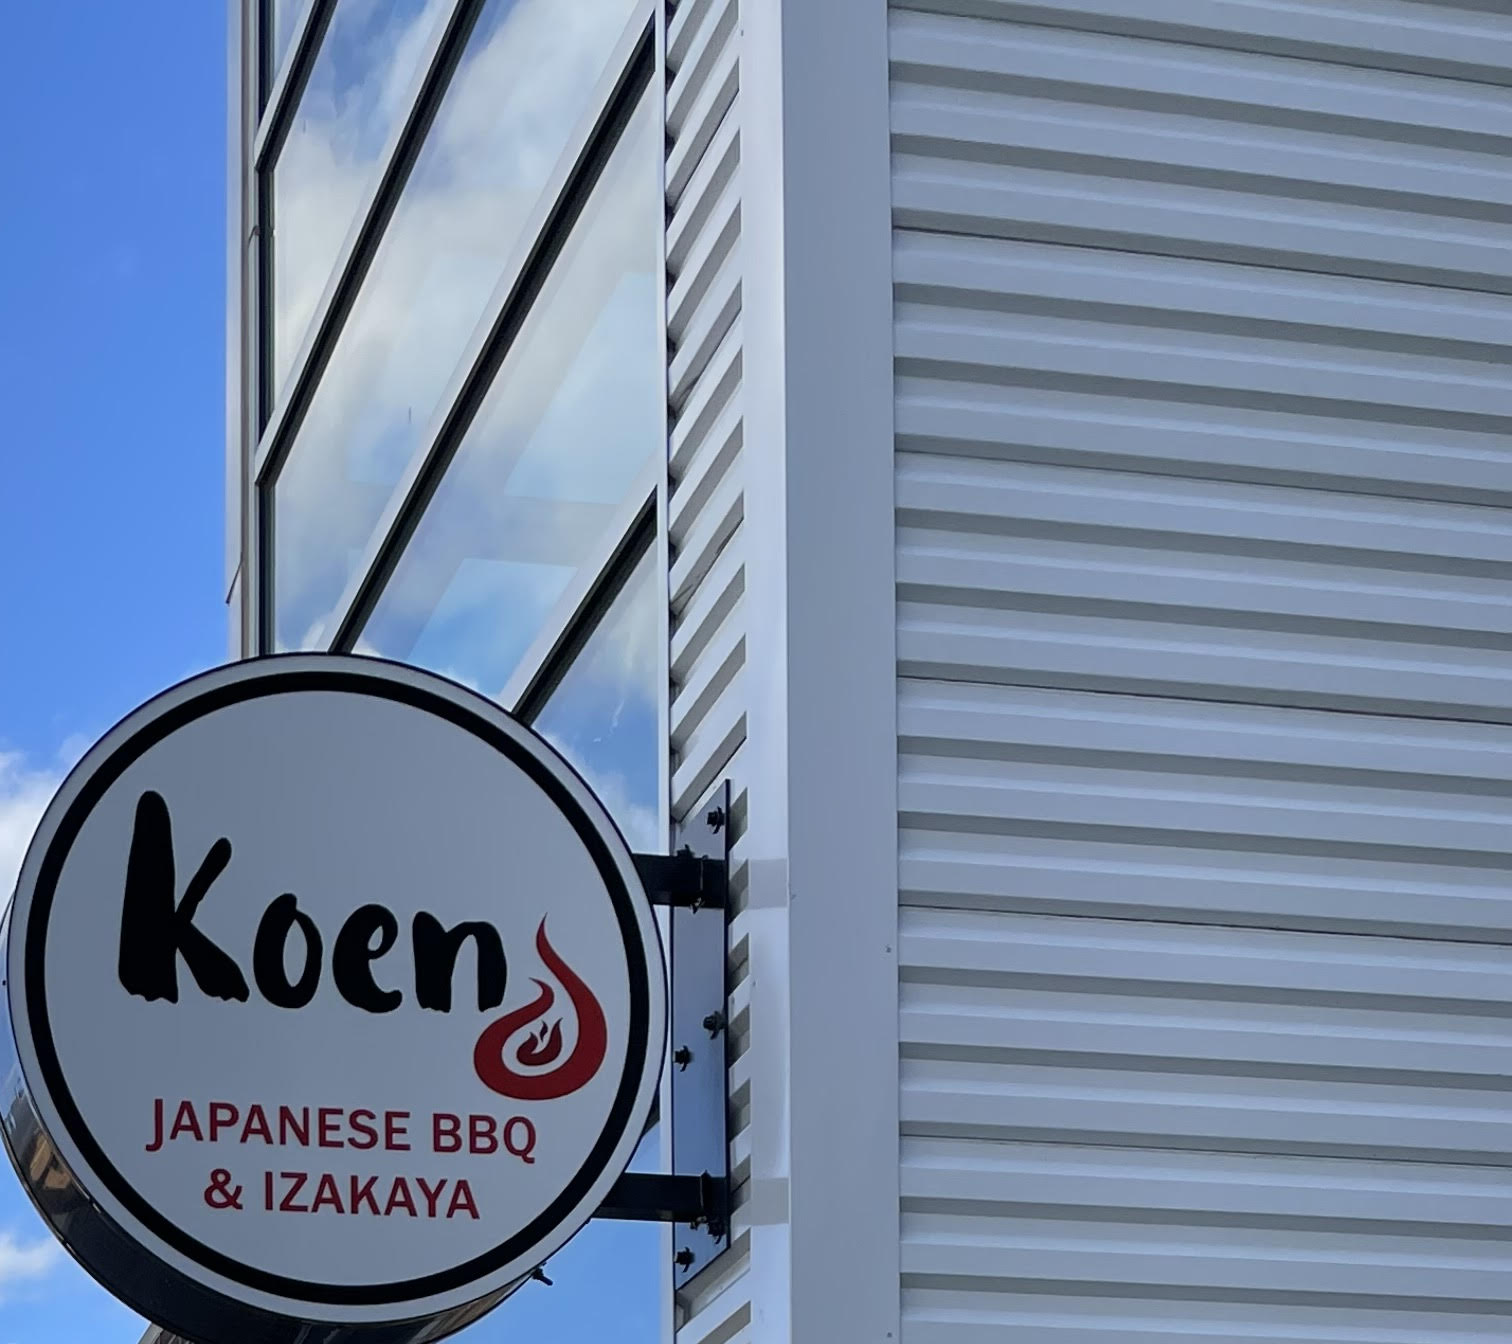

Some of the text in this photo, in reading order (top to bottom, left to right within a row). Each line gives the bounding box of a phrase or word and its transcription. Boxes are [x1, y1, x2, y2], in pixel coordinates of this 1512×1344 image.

[118, 790, 508, 1013] Koen
[145, 1098, 537, 1164] JAPANESE BBQ
[203, 1167, 481, 1219] & IZAKAYA
